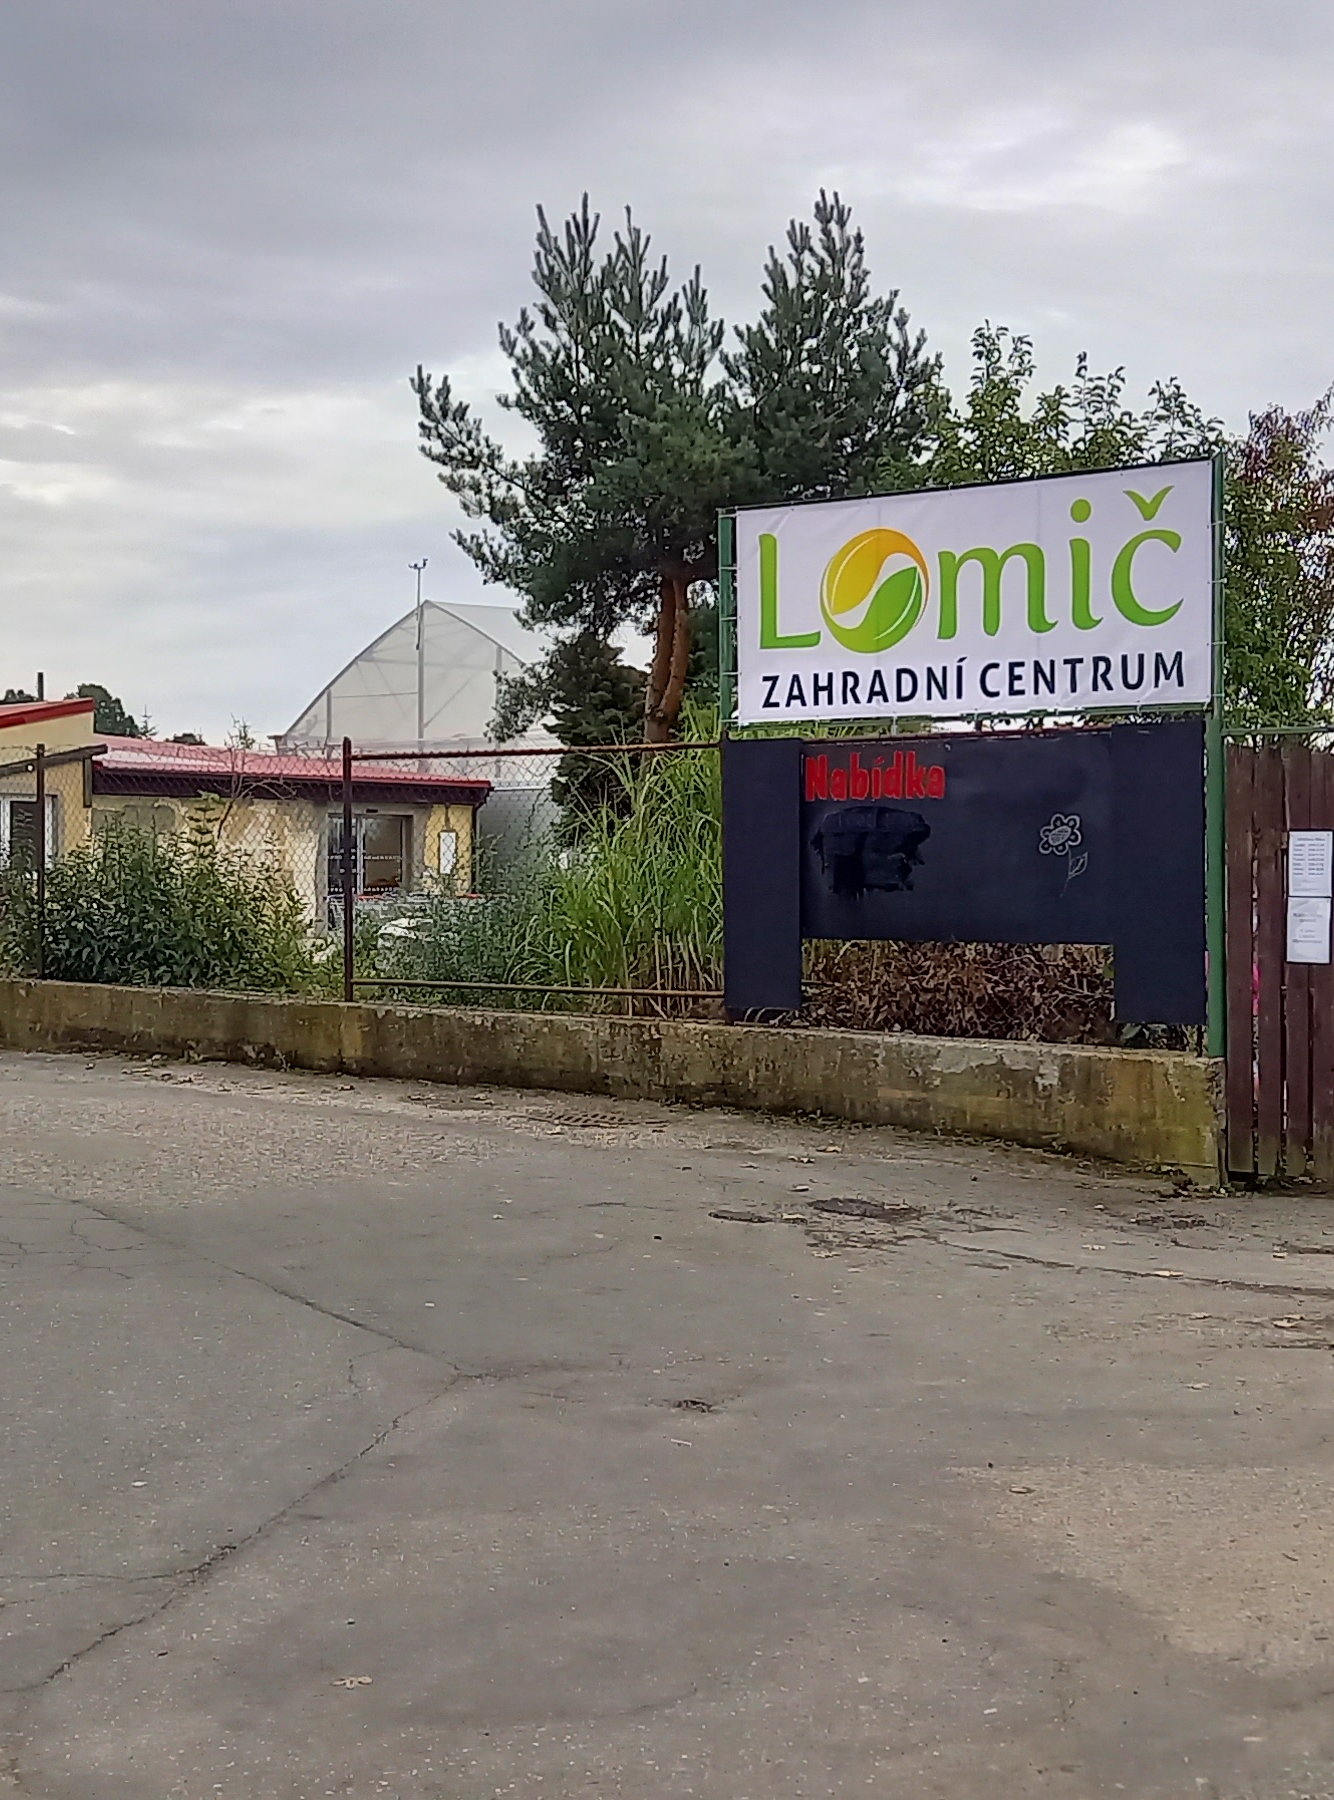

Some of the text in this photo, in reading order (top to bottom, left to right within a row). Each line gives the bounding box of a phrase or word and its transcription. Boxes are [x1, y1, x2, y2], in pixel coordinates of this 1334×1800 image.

[754, 484, 1184, 654] Lomič
[762, 651, 1184, 708] ZAHRADNÍ CENTRUM
[805, 750, 945, 801] Nabídka
